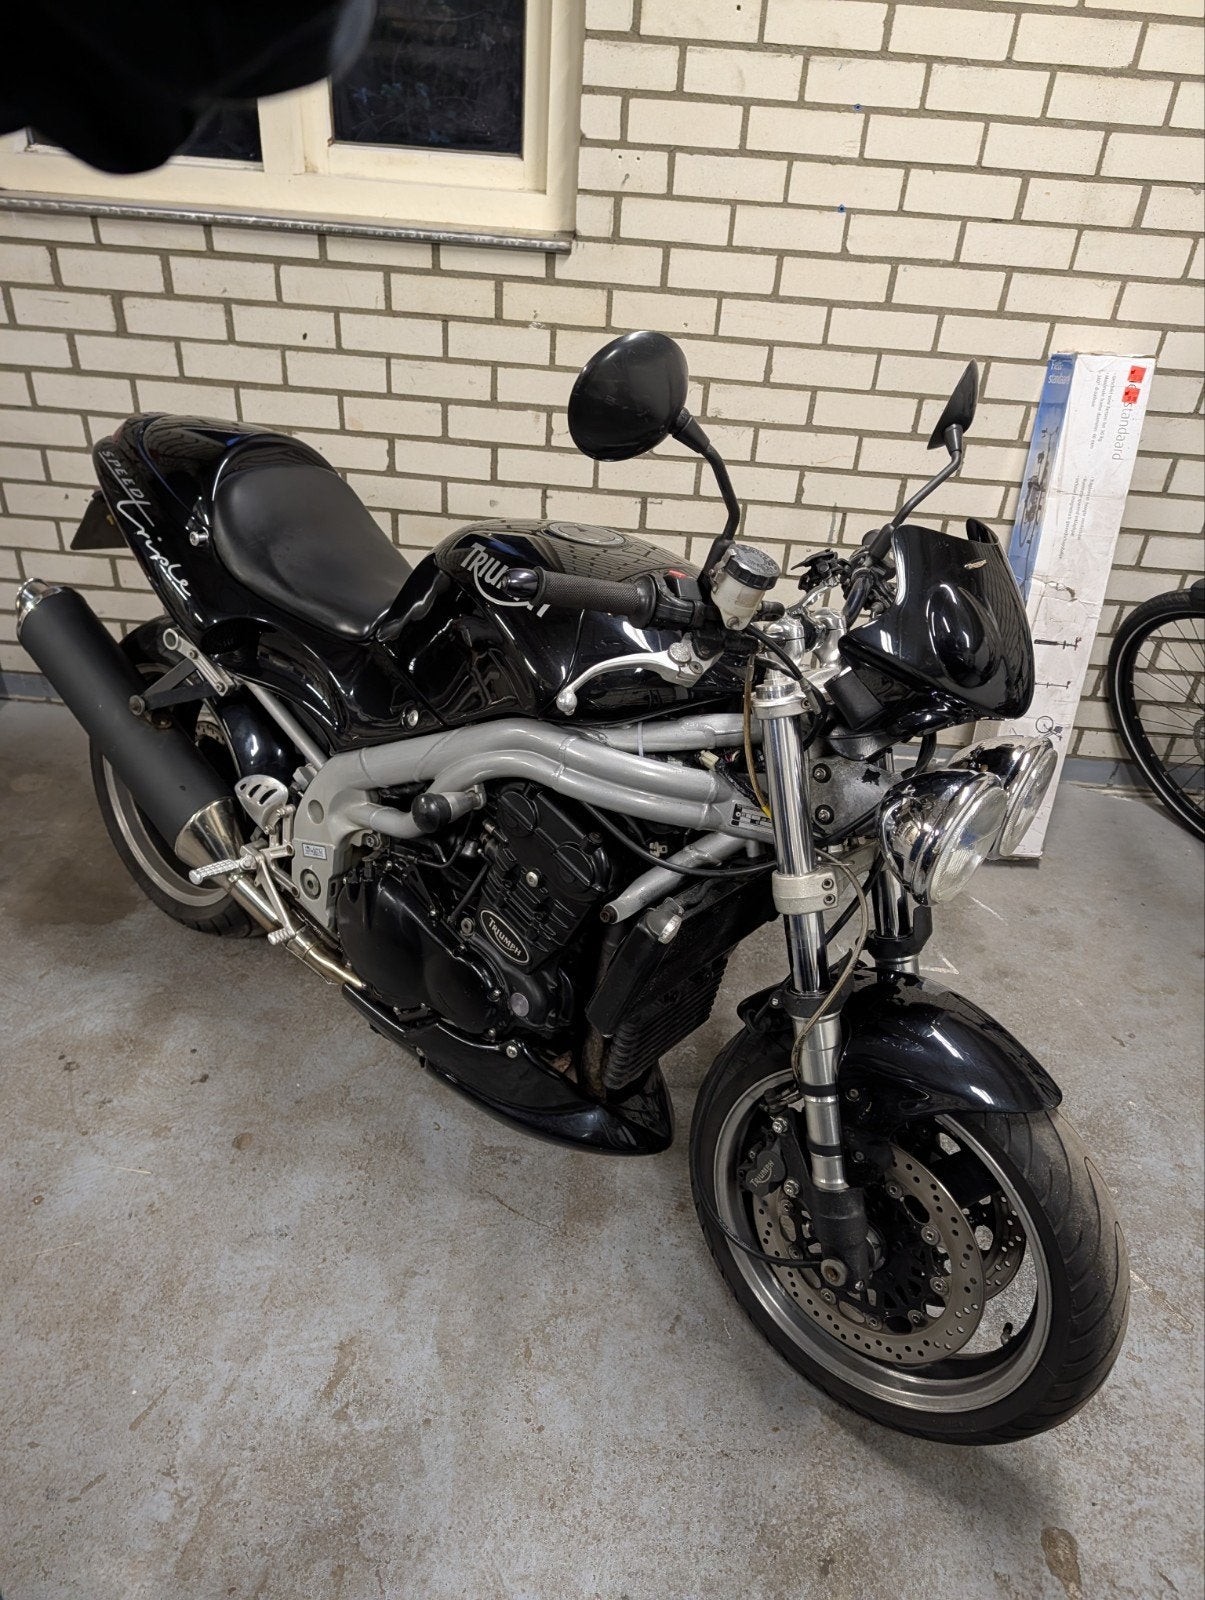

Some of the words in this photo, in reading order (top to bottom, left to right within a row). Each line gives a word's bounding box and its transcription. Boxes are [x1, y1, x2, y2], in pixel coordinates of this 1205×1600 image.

[102, 450, 145, 499] SPEED
[460, 542, 551, 618] TRIU
[488, 917, 521, 956] TRIUMPH
[750, 1160, 774, 1187] TRIUMPH
